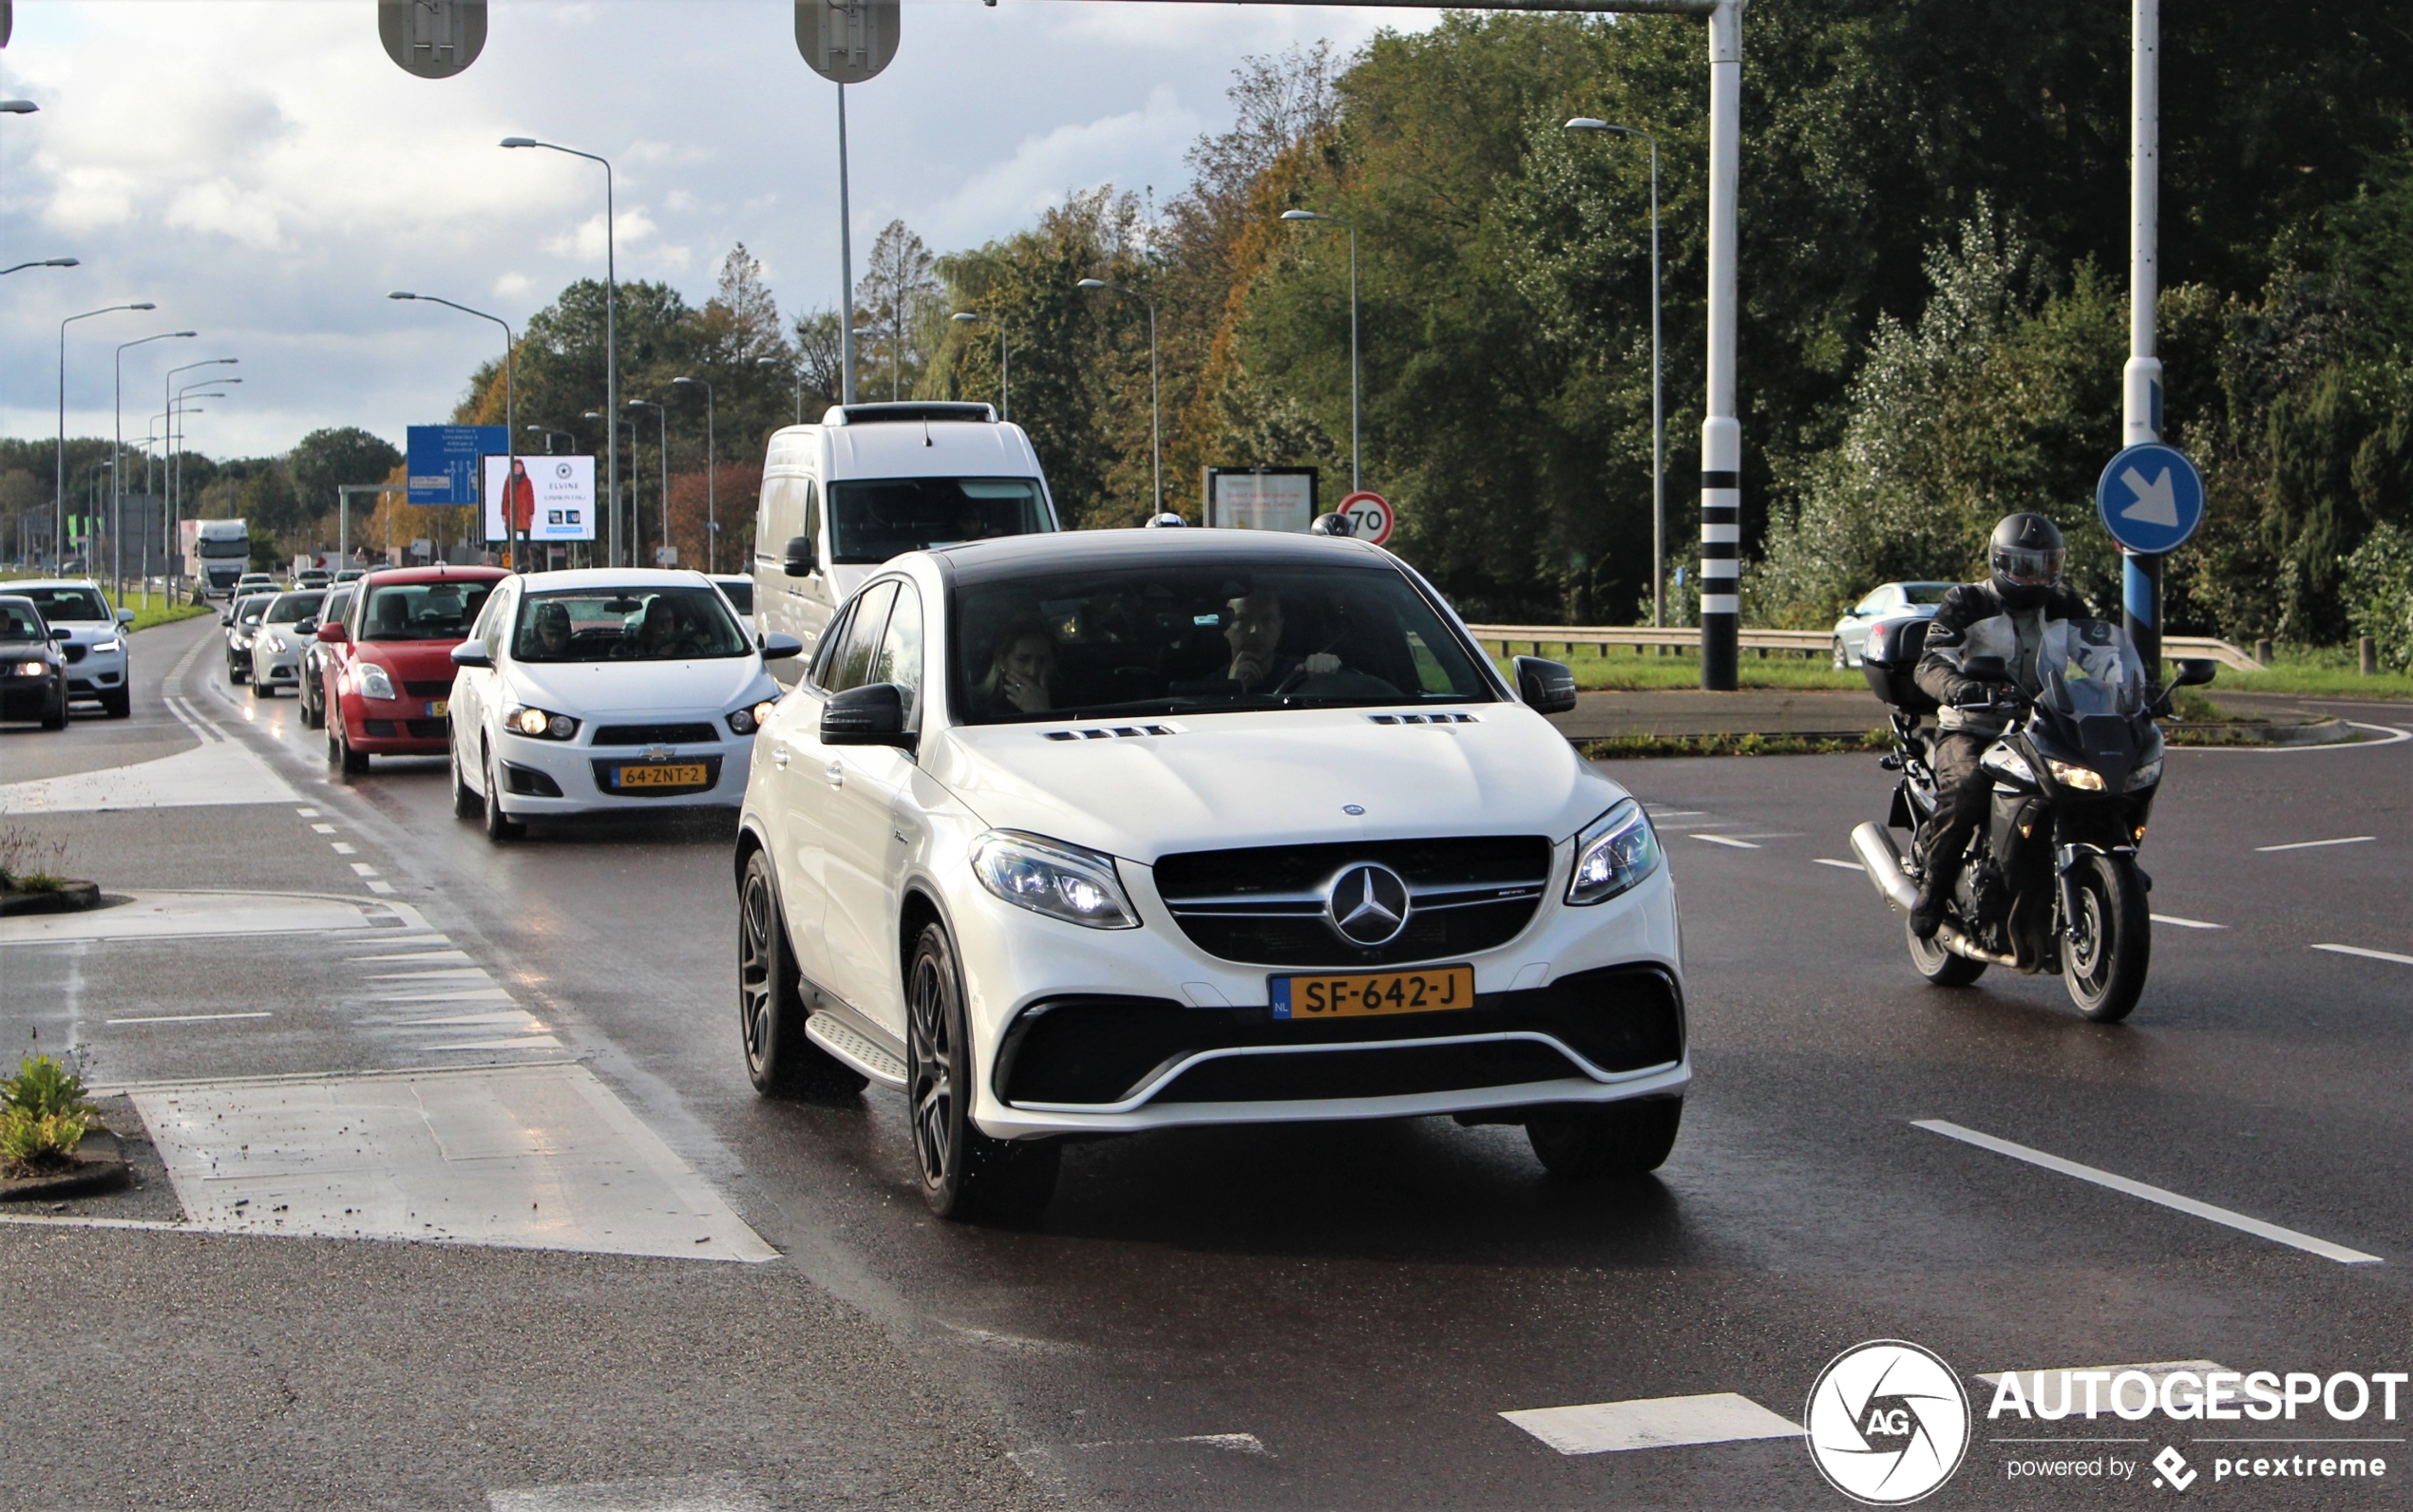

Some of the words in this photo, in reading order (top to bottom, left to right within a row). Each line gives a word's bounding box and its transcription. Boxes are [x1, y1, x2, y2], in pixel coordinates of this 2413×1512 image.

[1349, 510, 1382, 531] 70
[626, 767, 699, 784] 64-ZNT-2
[1305, 973, 1455, 1012] SF-642-J
[1274, 1002, 1289, 1012] NL
